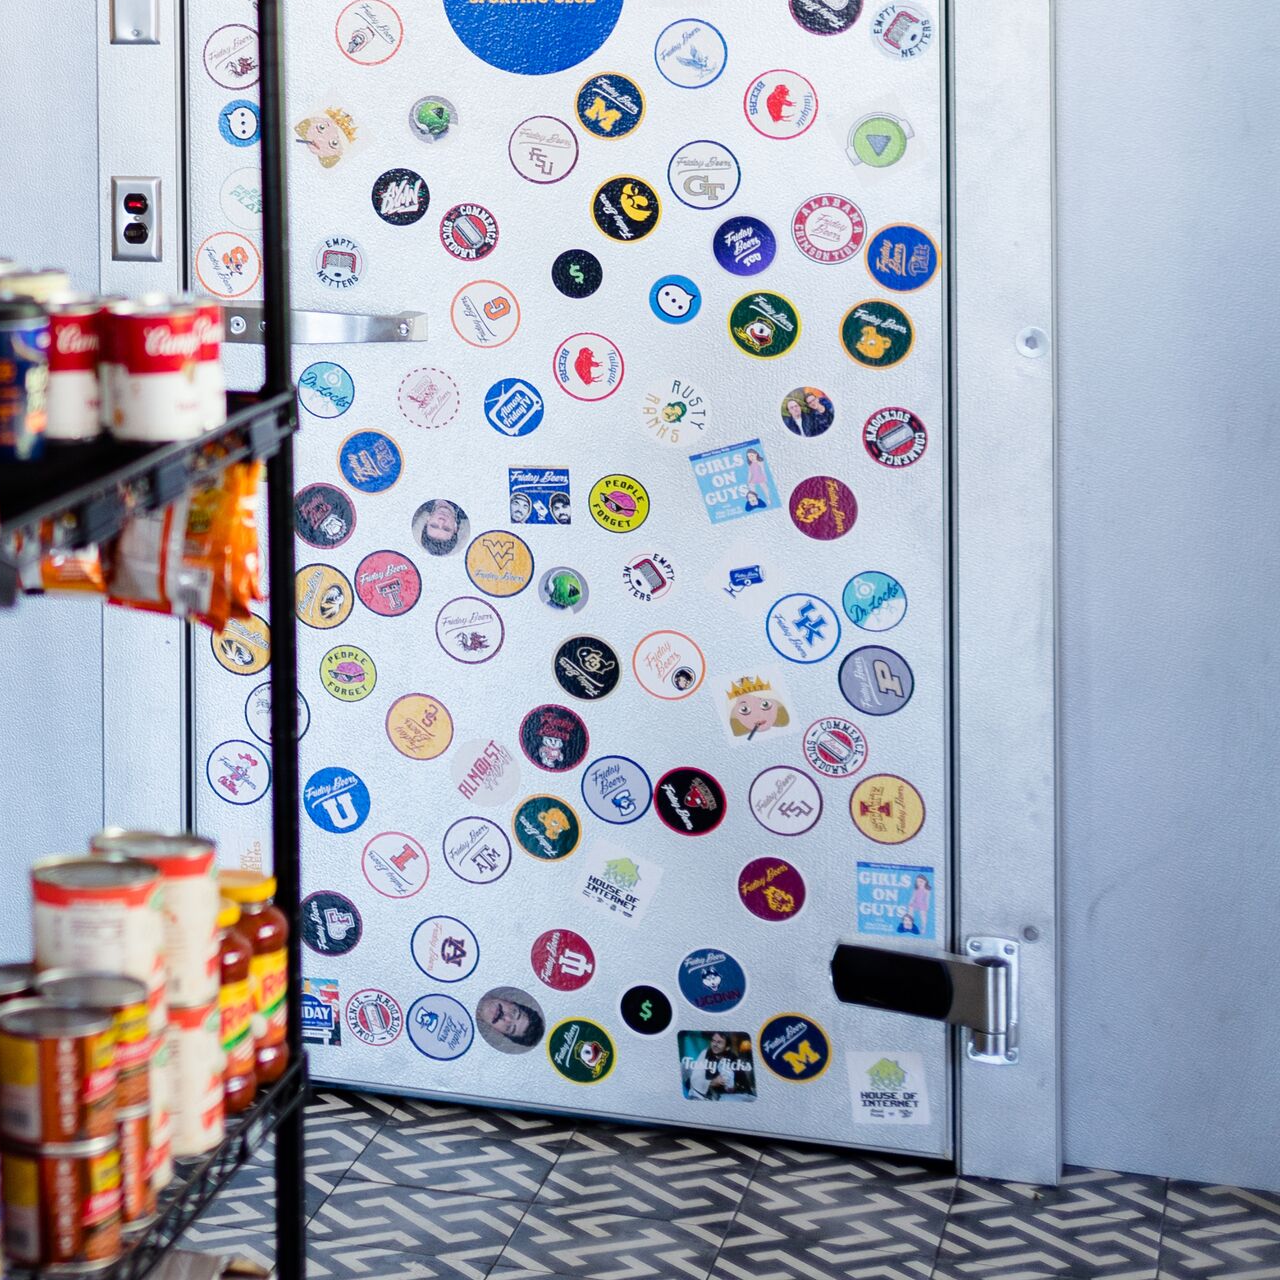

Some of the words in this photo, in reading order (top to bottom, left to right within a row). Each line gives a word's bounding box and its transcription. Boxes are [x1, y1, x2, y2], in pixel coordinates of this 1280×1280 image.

[873, 4, 897, 35] EMPTY
[900, 19, 932, 58] NETTERS
[749, 80, 766, 116] BEERS
[585, 96, 622, 132] M
[528, 146, 554, 176] FSU
[676, 156, 704, 169] Friday
[704, 156, 732, 168] Beers
[683, 174, 725, 201] GT
[459, 203, 498, 245] COMMENCE
[801, 195, 864, 234] ALABAMA
[325, 237, 358, 252] EMPTY
[724, 225, 754, 247] Friday
[733, 236, 762, 258] Beers
[794, 223, 831, 262] CRIMSON
[742, 251, 762, 267] TCU
[316, 269, 360, 289] NETTERS
[558, 347, 571, 384] BEERS
[606, 348, 619, 387] Tailgate
[315, 385, 351, 409] Locks
[500, 391, 524, 421] Almost
[522, 395, 534, 412] TV
[671, 379, 707, 431] RUSTY
[865, 409, 912, 443] SUCKDOWN
[879, 431, 927, 467] COMMENCE
[510, 470, 540, 483] Friday
[540, 470, 569, 483] Beers
[694, 453, 745, 477] GIRLS
[605, 479, 645, 504] PEOPLE
[711, 471, 738, 489] ON
[704, 484, 750, 506] GUYS
[592, 503, 633, 528] FORGET
[653, 553, 675, 582] EMPTY
[622, 565, 652, 602] NETTERS
[850, 604, 870, 624] Dr.
[869, 580, 900, 608] Locks
[326, 651, 368, 667] PEOPLE
[326, 680, 368, 697] FORGET
[872, 659, 905, 698] P
[819, 720, 865, 758] COMMENCE
[806, 739, 849, 775] SUCKDOWN
[304, 784, 332, 801] Friday
[332, 775, 359, 791] Beers
[321, 792, 360, 829] U
[777, 800, 814, 819] FSU
[588, 874, 622, 898] HOUSE
[624, 892, 640, 905] OF
[859, 871, 912, 888] GIRLS
[584, 882, 638, 913] INTERNET
[872, 887, 900, 902] ON
[859, 902, 910, 918] GUYS
[349, 996, 375, 1043] COMMENCE
[375, 993, 401, 1038] SUCKDOWN
[639, 999, 653, 1022] $
[782, 1039, 821, 1075] M
[860, 1092, 896, 1100] HOUSE
[903, 1092, 918, 1100] OF
[861, 1100, 919, 1108] INTERNET
